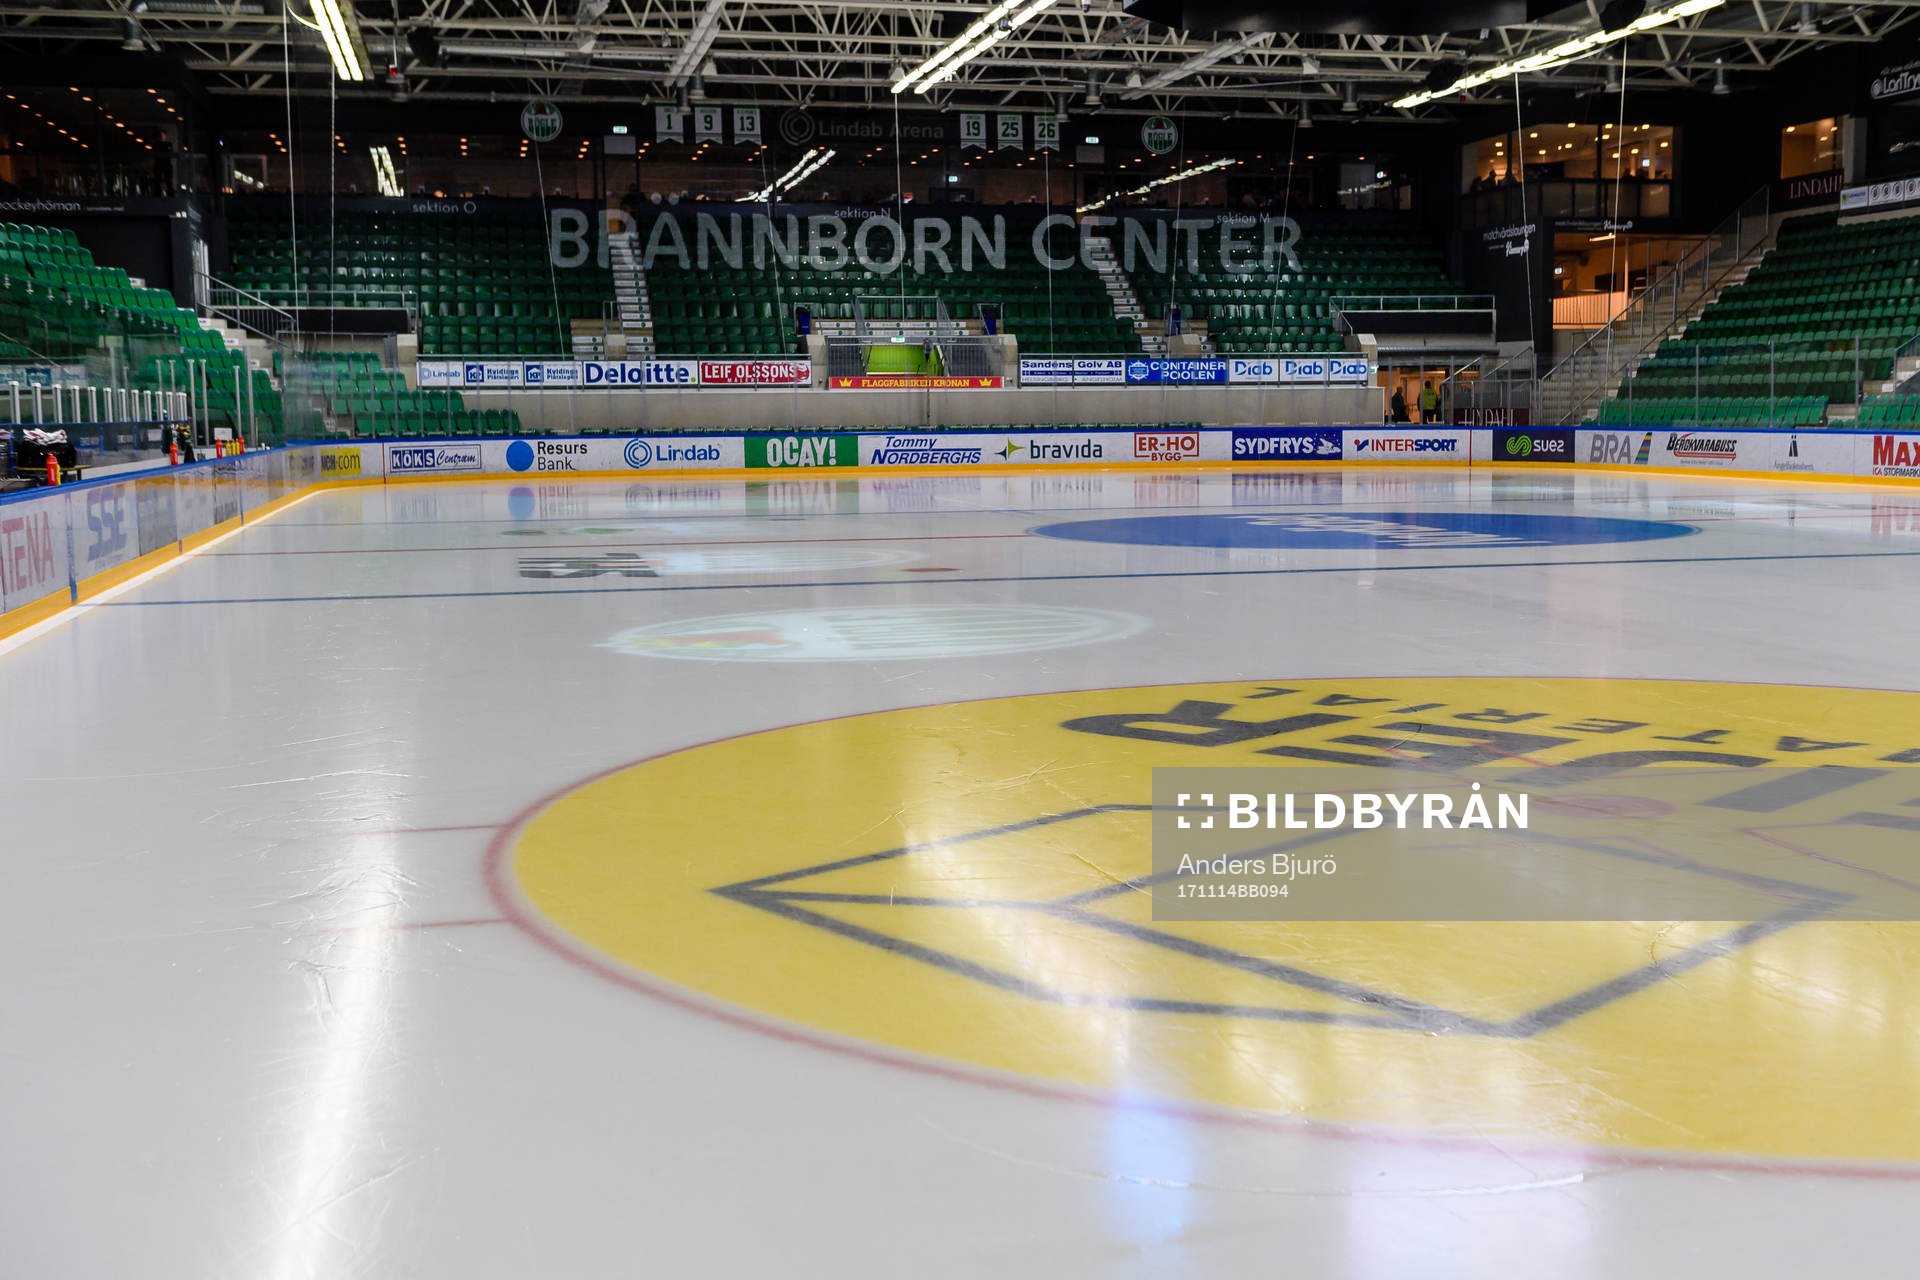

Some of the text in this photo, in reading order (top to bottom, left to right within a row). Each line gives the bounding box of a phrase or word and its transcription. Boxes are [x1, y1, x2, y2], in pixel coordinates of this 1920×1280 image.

[666, 114, 673, 130] 1
[704, 115, 713, 131] 9
[739, 116, 755, 131] 13
[818, 119, 944, 139] Lindab Arena
[966, 121, 981, 137] 19
[1001, 122, 1019, 138] 25
[1038, 123, 1056, 138] 26
[412, 201, 476, 214] sektion O
[834, 207, 891, 219] sektion N
[1216, 213, 1270, 224] sektion M
[550, 192, 1302, 275] BRÄNNBORN CENTER
[704, 365, 796, 379] LEIF OLSSONS
[1022, 360, 1122, 369] Sandens Golv AB
[1150, 361, 1226, 371] CONTAINER
[1234, 361, 1273, 376] Diab
[1285, 361, 1323, 376] Diab
[1330, 360, 1367, 375] Diab
[933, 379, 970, 387] KRONAN
[1162, 371, 1216, 380] POOLEN
[537, 441, 588, 454] Resurs
[885, 436, 938, 450] Tommy
[1030, 438, 1103, 459] bravida
[1138, 436, 1196, 451] ER-HO
[1234, 436, 1314, 455] SYDFRYS
[1371, 439, 1458, 452] INTERSPORT
[1589, 433, 1632, 464] BRA
[392, 450, 476, 468] KÖKS Centrum
[656, 444, 720, 461] Lindab
[766, 436, 836, 467] OCAY!
[871, 448, 982, 465] NORDBERGHS
[1151, 452, 1182, 461] BYGG
[537, 457, 573, 470] Bank
[0, 511, 55, 597] TENA
